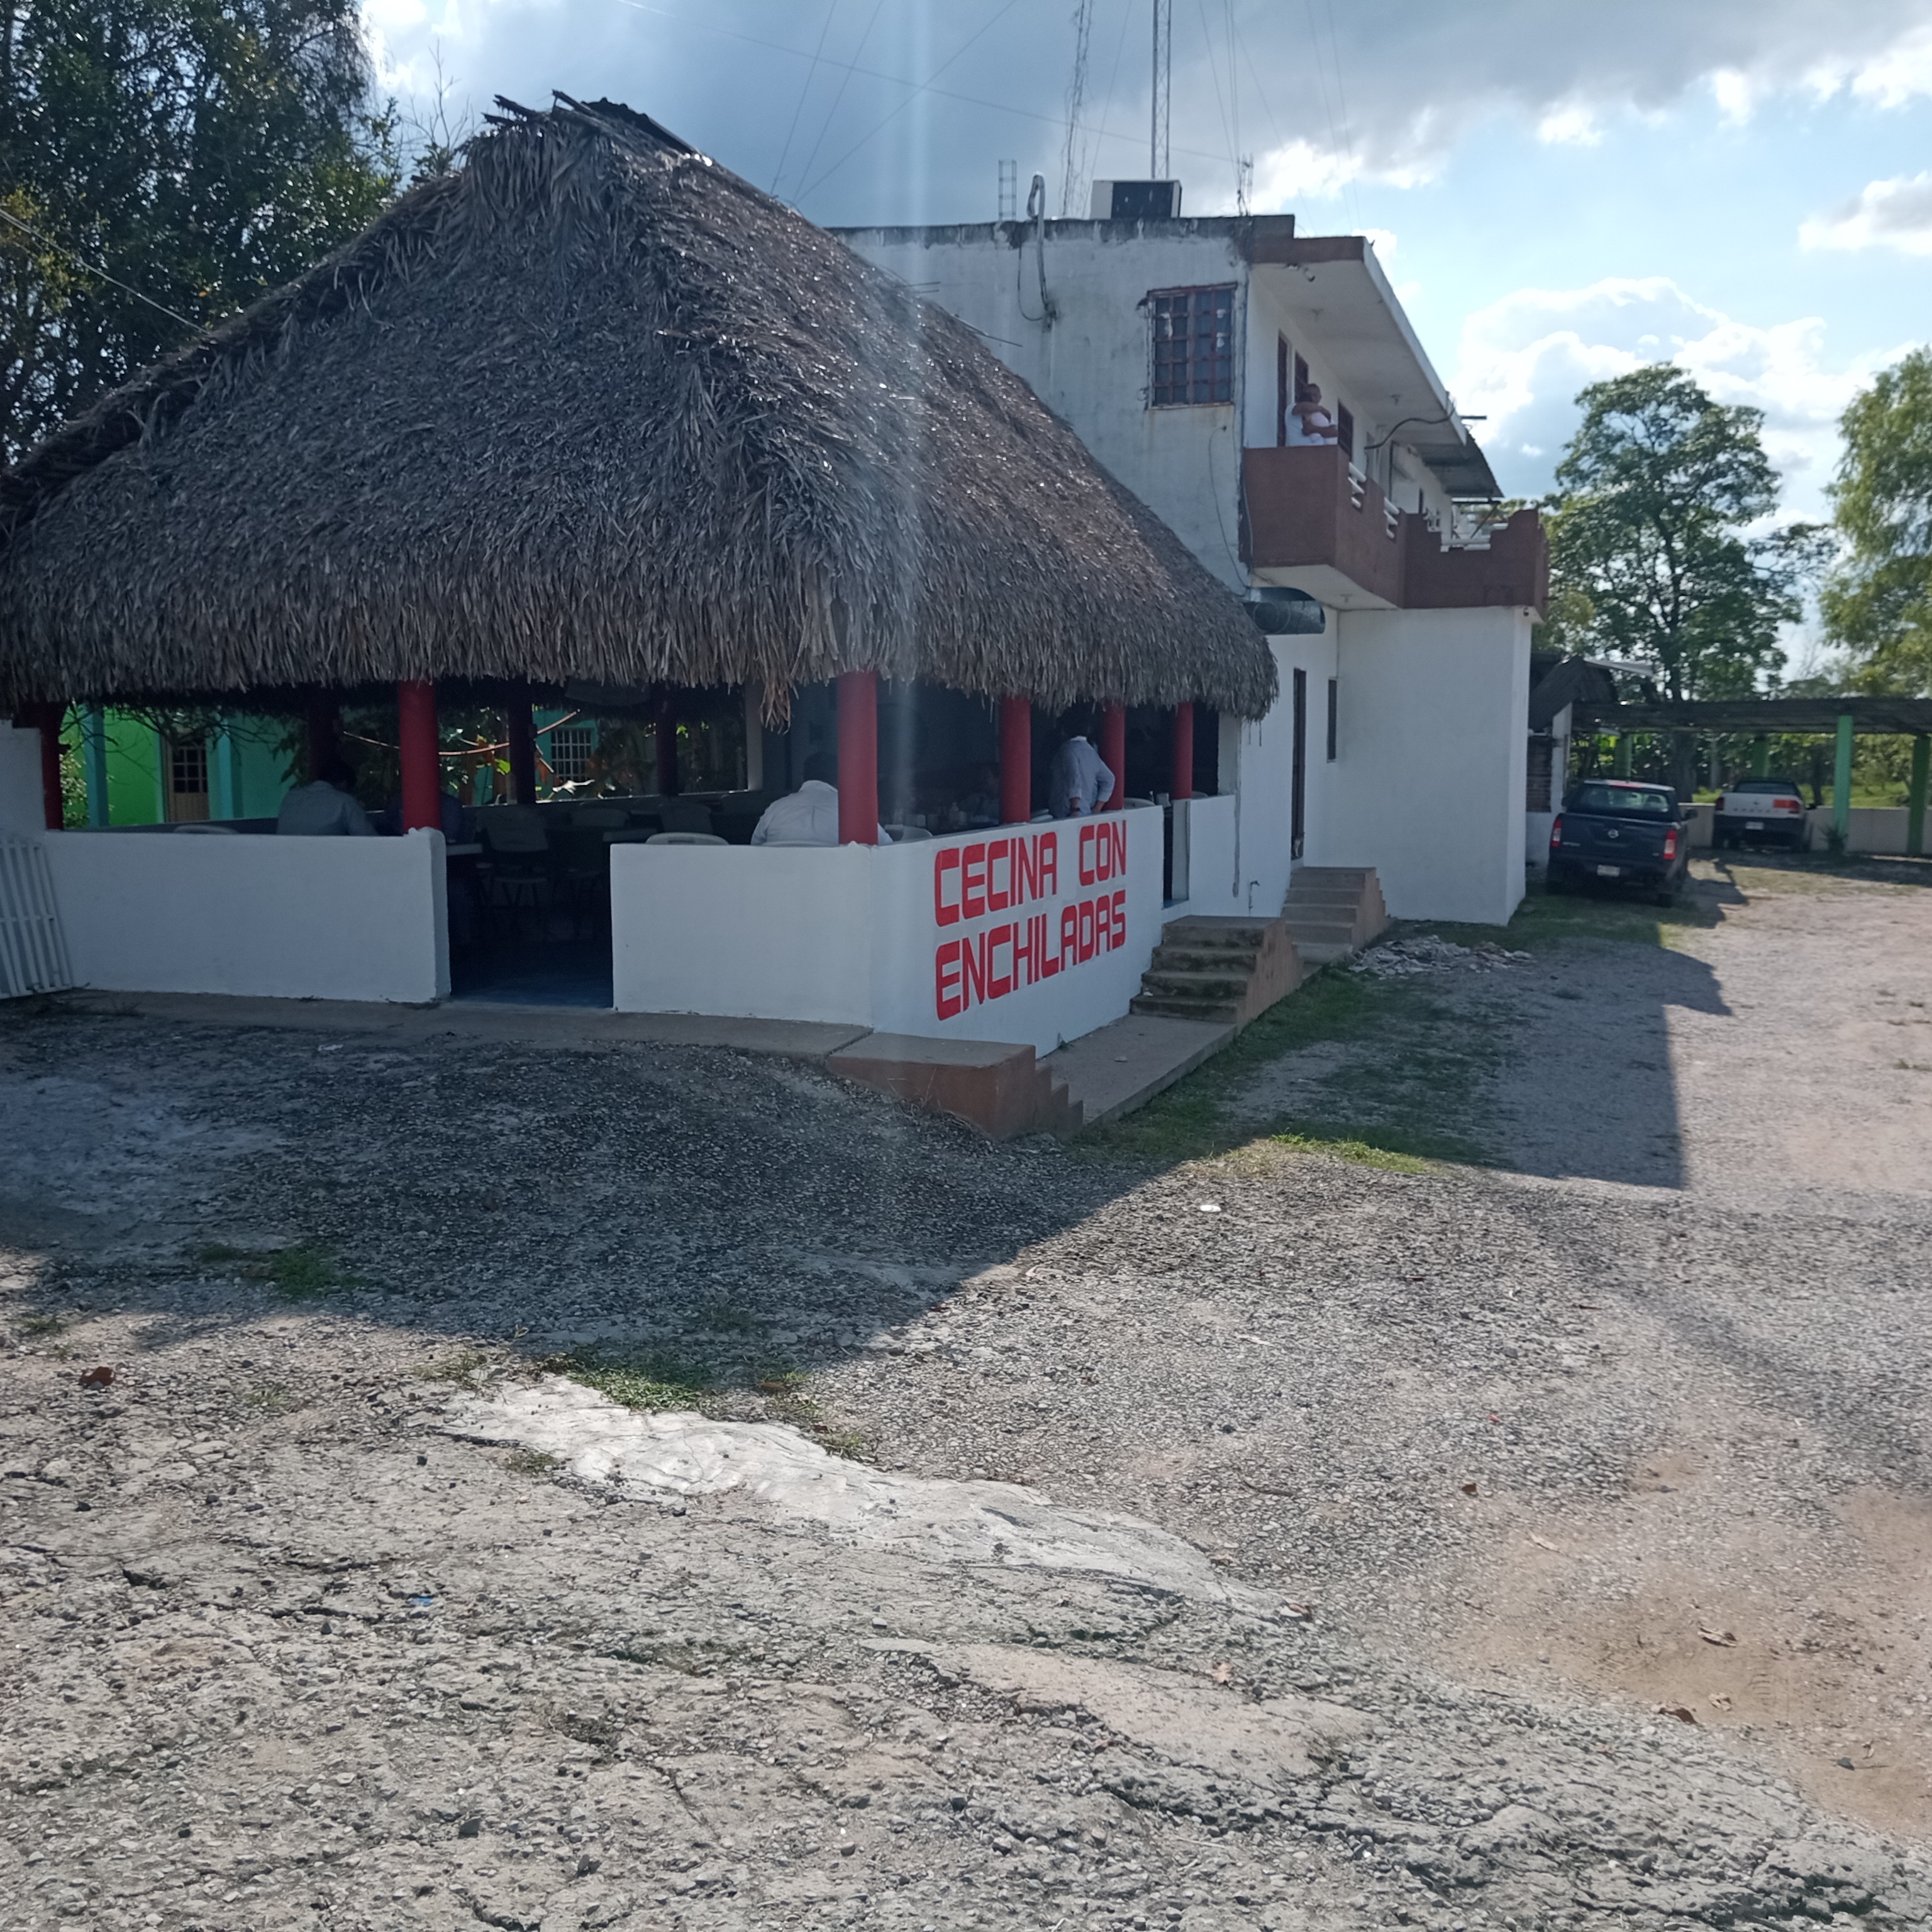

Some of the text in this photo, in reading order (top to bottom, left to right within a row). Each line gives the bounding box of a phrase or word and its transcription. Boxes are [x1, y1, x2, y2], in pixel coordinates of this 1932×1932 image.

[935, 820, 1126, 927] CECINA CON
[935, 890, 1126, 1021] ENCHILADAS
